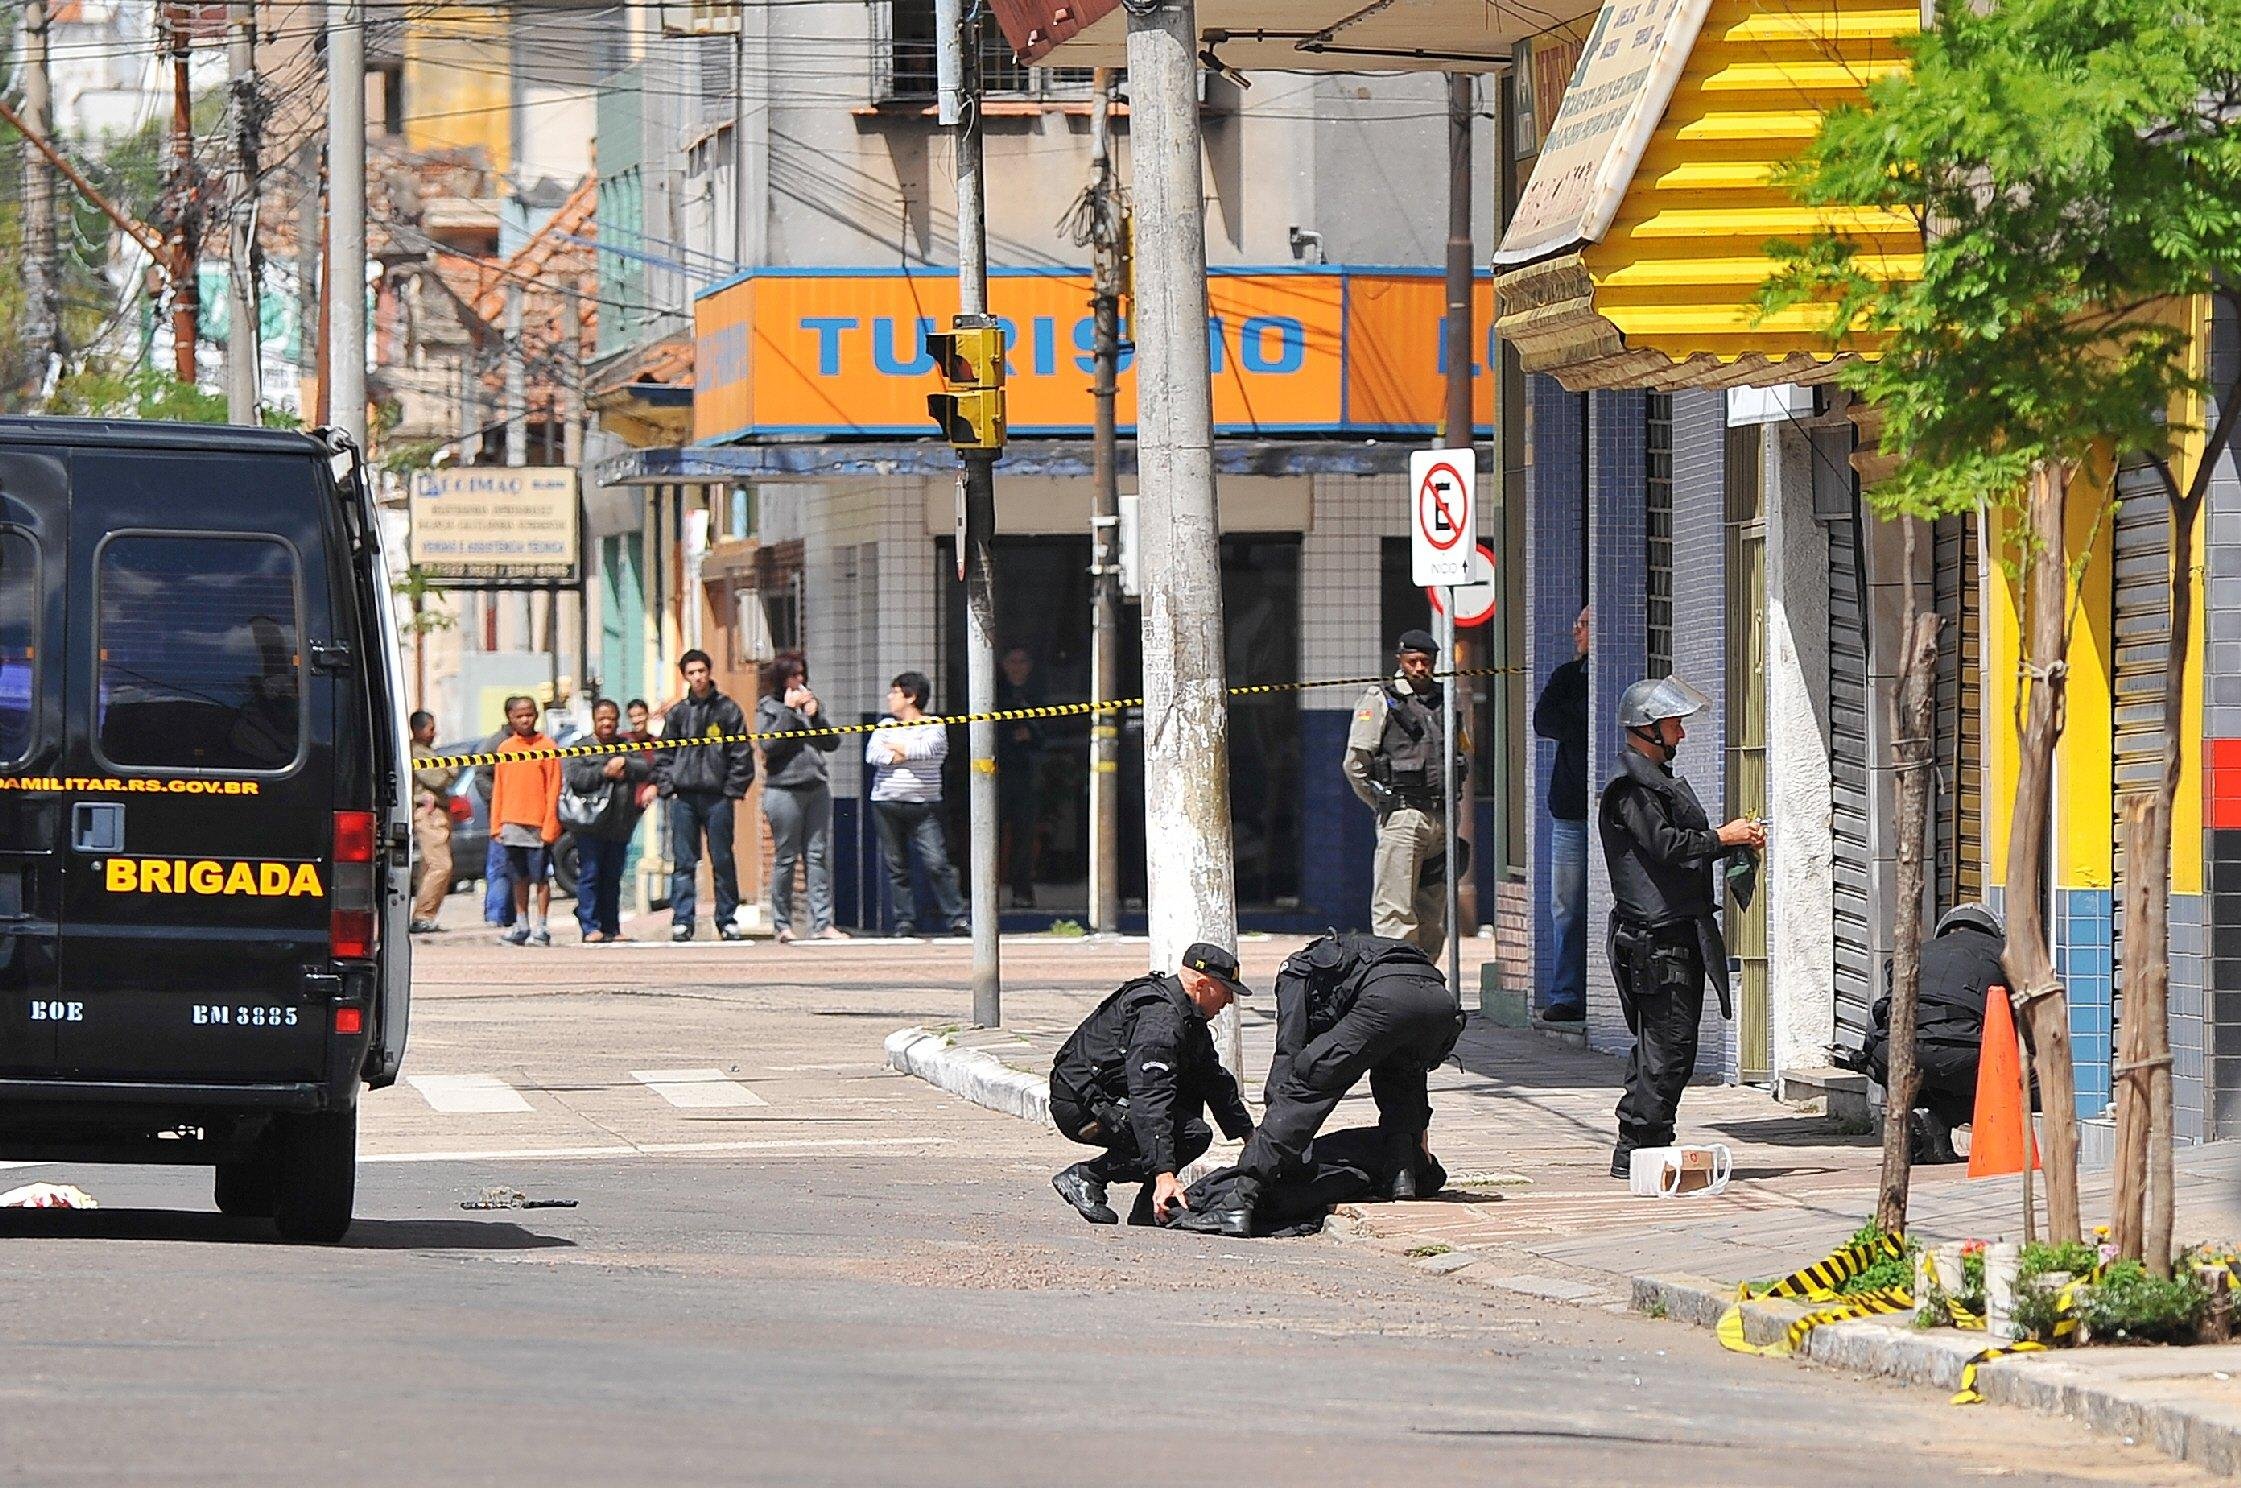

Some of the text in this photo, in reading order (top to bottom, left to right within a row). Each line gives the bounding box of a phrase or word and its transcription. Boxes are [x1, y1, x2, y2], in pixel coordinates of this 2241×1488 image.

[800, 316, 1305, 376] TUISO
[106, 858, 324, 897] BRIGADA
[30, 1000, 84, 1021] BOE
[192, 1005, 298, 1026] BM 3885
